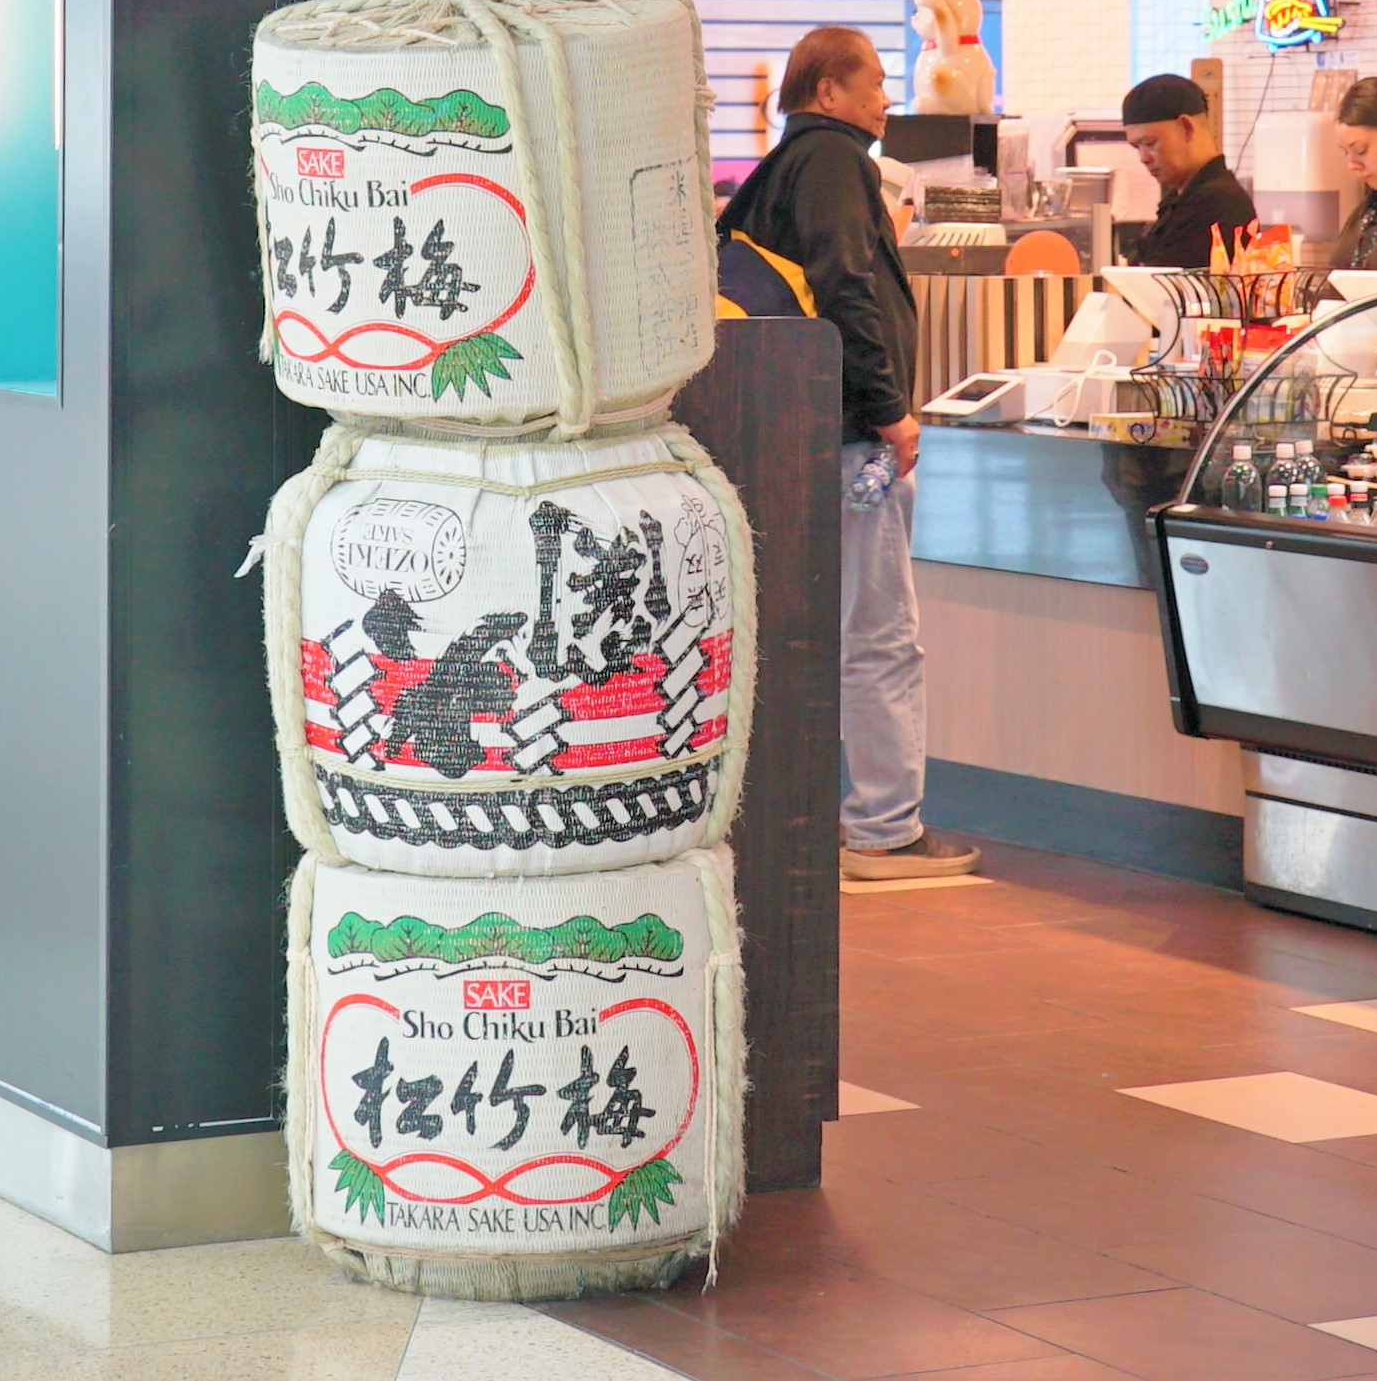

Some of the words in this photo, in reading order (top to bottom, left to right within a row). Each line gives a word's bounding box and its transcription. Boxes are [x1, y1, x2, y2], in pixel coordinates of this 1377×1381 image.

[298, 149, 343, 176] SAKE
[270, 174, 294, 204] Sho
[299, 179, 358, 210] Chiku
[368, 181, 408, 208] Bai
[277, 354, 313, 388] TAKARA
[317, 367, 350, 395] SAKE
[356, 373, 390, 398] USA
[393, 376, 430, 400] INC.
[363, 524, 414, 545] SAKE
[349, 542, 428, 573] OZEKI
[465, 982, 528, 1008] SAKE
[403, 1010, 453, 1040] Sho
[463, 1012, 544, 1043] Chiku
[556, 1009, 598, 1037] Bai
[385, 1203, 460, 1232] TAKARA
[468, 1209, 515, 1233] SAKE
[523, 1207, 566, 1232] USA
